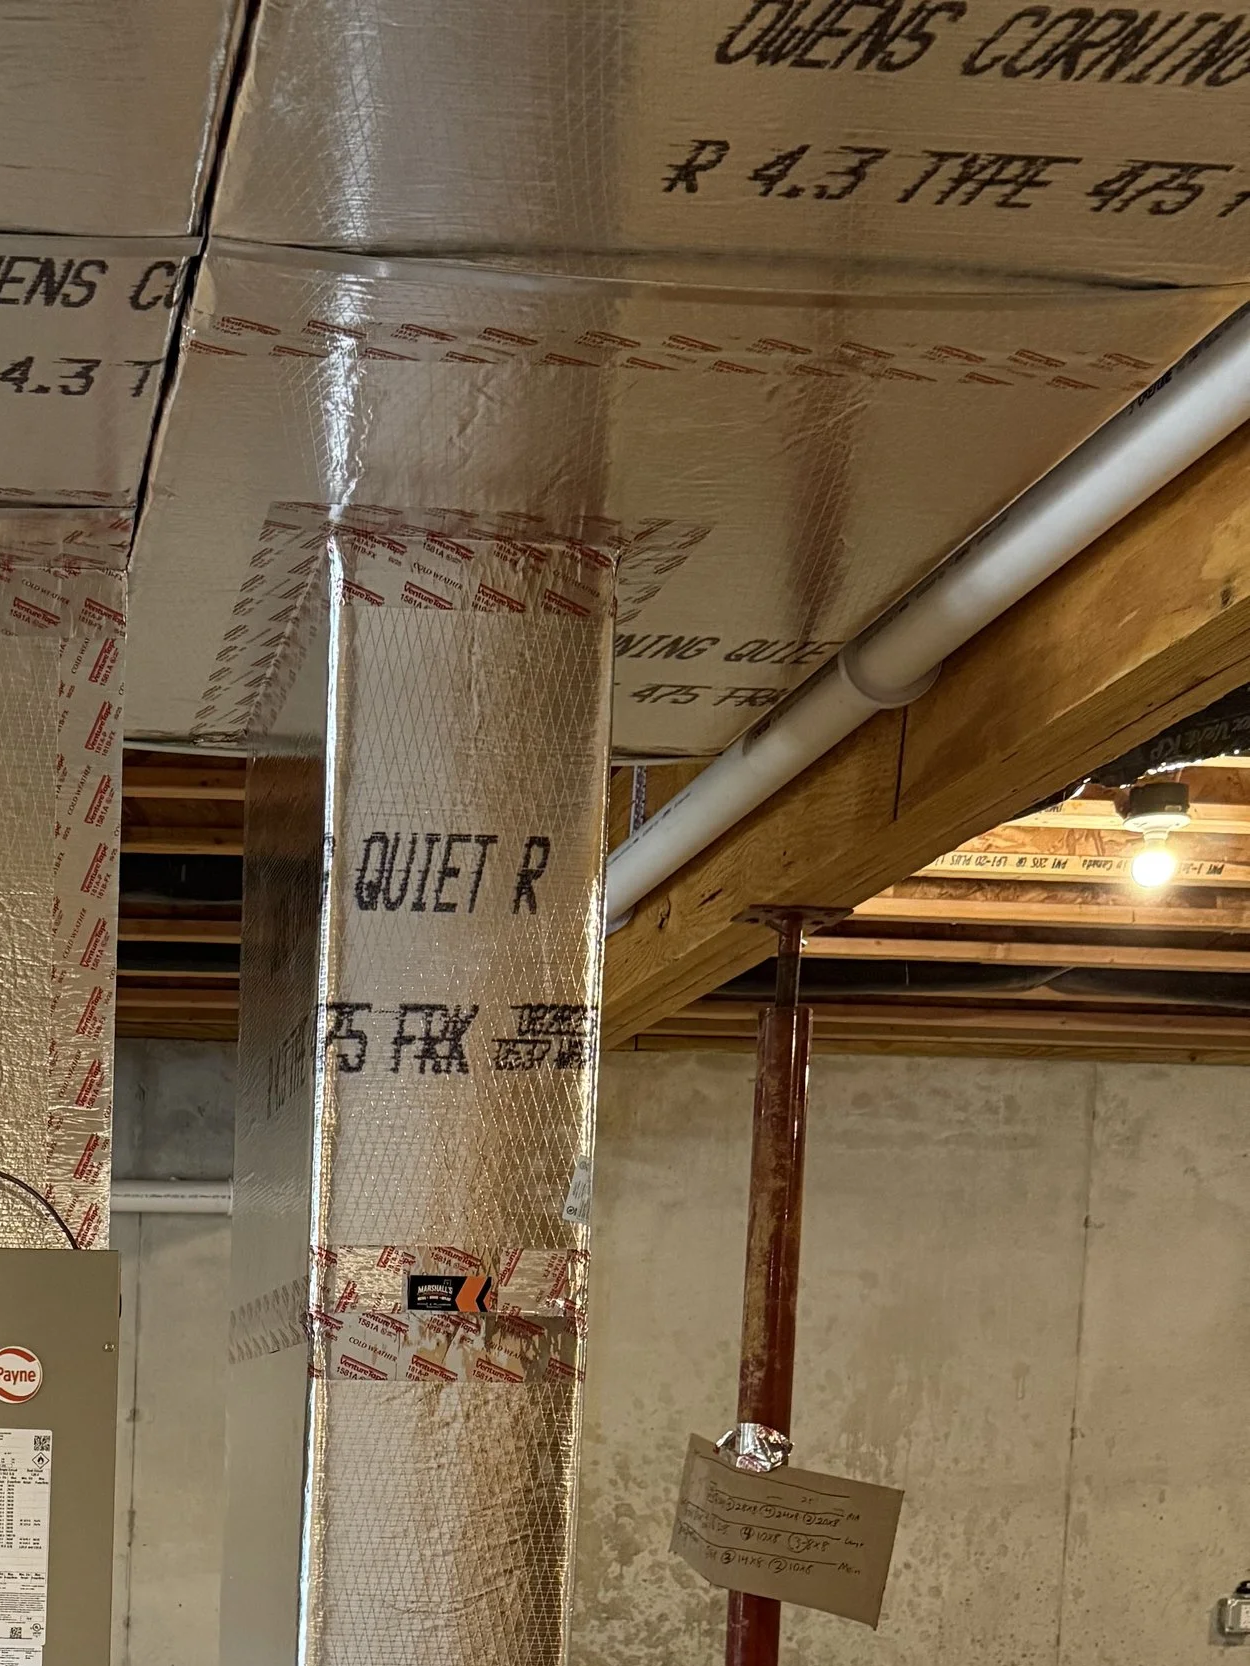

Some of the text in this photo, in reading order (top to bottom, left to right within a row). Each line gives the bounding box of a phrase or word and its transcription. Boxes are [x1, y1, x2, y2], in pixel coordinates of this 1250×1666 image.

[715, 0, 967, 72] OWENS
[662, 139, 730, 193] R
[749, 144, 891, 200] 4.3
[898, 148, 1083, 209] TYPE
[1087, 159, 1235, 217] 475
[630, 684, 712, 704] 475
[84, 844, 109, 893] VentureTape
[354, 832, 550, 914] QUIET R
[82, 918, 107, 968] VentureTape
[391, 1004, 479, 1074] FRK
